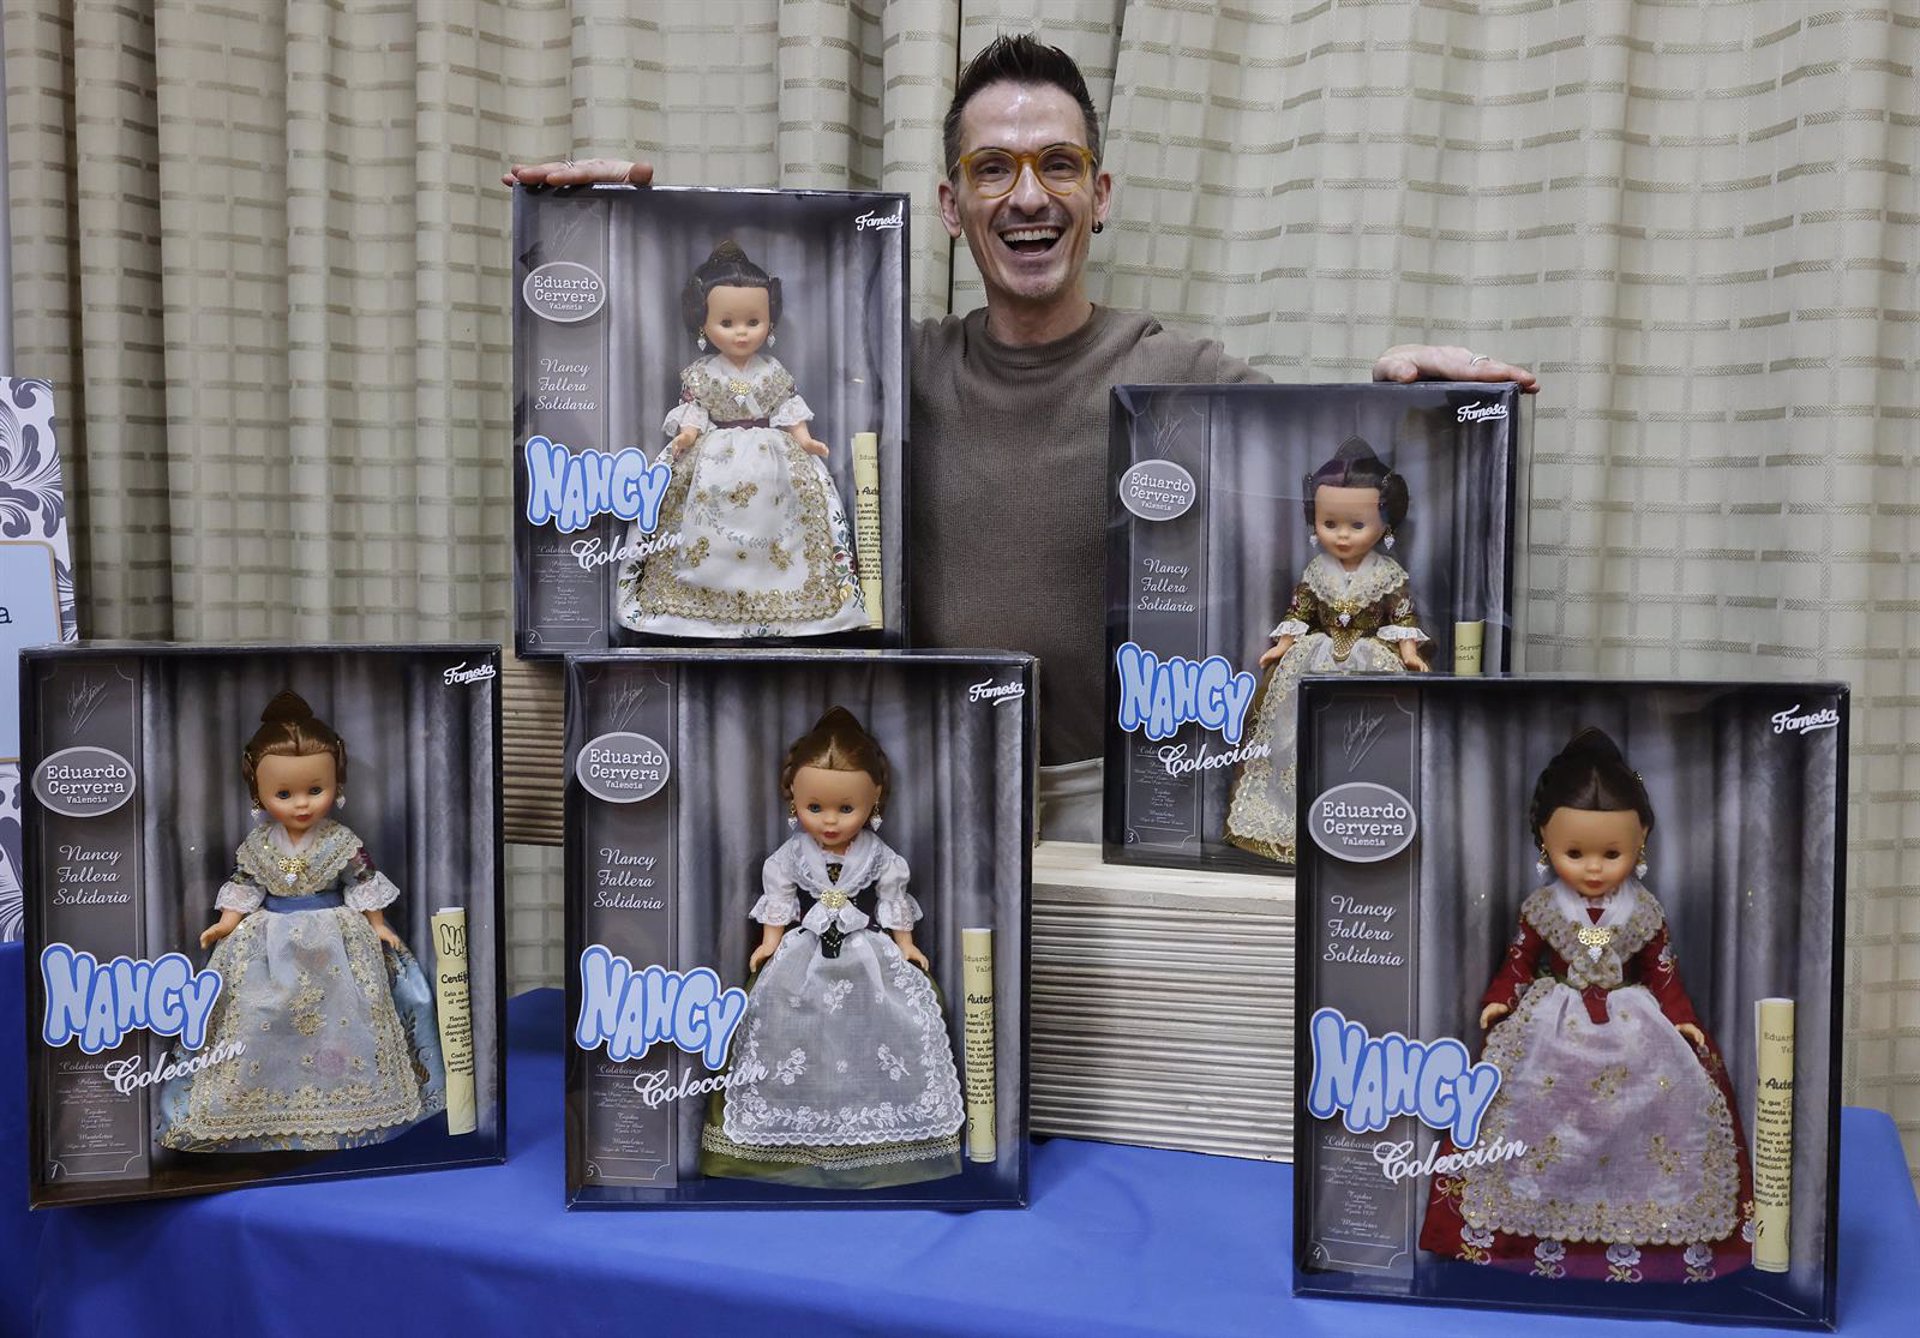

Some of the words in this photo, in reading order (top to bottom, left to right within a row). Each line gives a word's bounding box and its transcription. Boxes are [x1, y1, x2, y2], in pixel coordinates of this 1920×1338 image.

[855, 210, 904, 231] Famosa
[533, 275, 599, 291] Eduardo
[534, 289, 597, 303] Cervera
[549, 302, 583, 311] Valencia
[540, 359, 590, 379] Nancy
[538, 377, 588, 392] Fallera
[534, 396, 597, 411] Solidaria
[1457, 401, 1508, 423] Famosa
[524, 435, 672, 534] NANCY
[1131, 473, 1190, 493] Eduardo
[1130, 486, 1186, 505] Cervera
[571, 531, 686, 572] Colección
[1143, 558, 1191, 579] Nancy
[1141, 577, 1188, 594] Fallera
[1138, 596, 1196, 613] Solidaria
[443, 661, 497, 686] Famosa
[969, 678, 1025, 707] Famosa
[1117, 641, 1256, 744] NANCY
[1771, 704, 1840, 735] Famosa
[590, 748, 662, 766] Eduardo
[1158, 740, 1272, 779] Colección
[47, 765, 127, 780] Eduardo
[590, 764, 659, 782] Cervera
[48, 780, 125, 796] Cervera
[605, 779, 643, 790] Valencia
[66, 795, 107, 805] Valencia
[1322, 801, 1406, 819] Eduardo
[1323, 817, 1404, 837] Cervera
[1342, 836, 1386, 847] Valencia
[60, 844, 121, 867] Nancy
[600, 848, 657, 871] Nancy
[57, 866, 120, 884] Fallera
[597, 869, 654, 888] Fallera
[53, 888, 131, 906] Solidaria
[594, 891, 664, 912] Solidaria
[1331, 894, 1396, 922] Nancy
[1328, 919, 1393, 941] Fallera
[1323, 943, 1404, 966] Solidaria
[41, 942, 223, 1055] NANCY
[576, 944, 748, 1070] NANCY
[104, 1039, 247, 1096] Colección
[634, 1066, 768, 1110] Colección
[1308, 1007, 1502, 1150] NANCY
[1373, 1137, 1529, 1185] Colección
